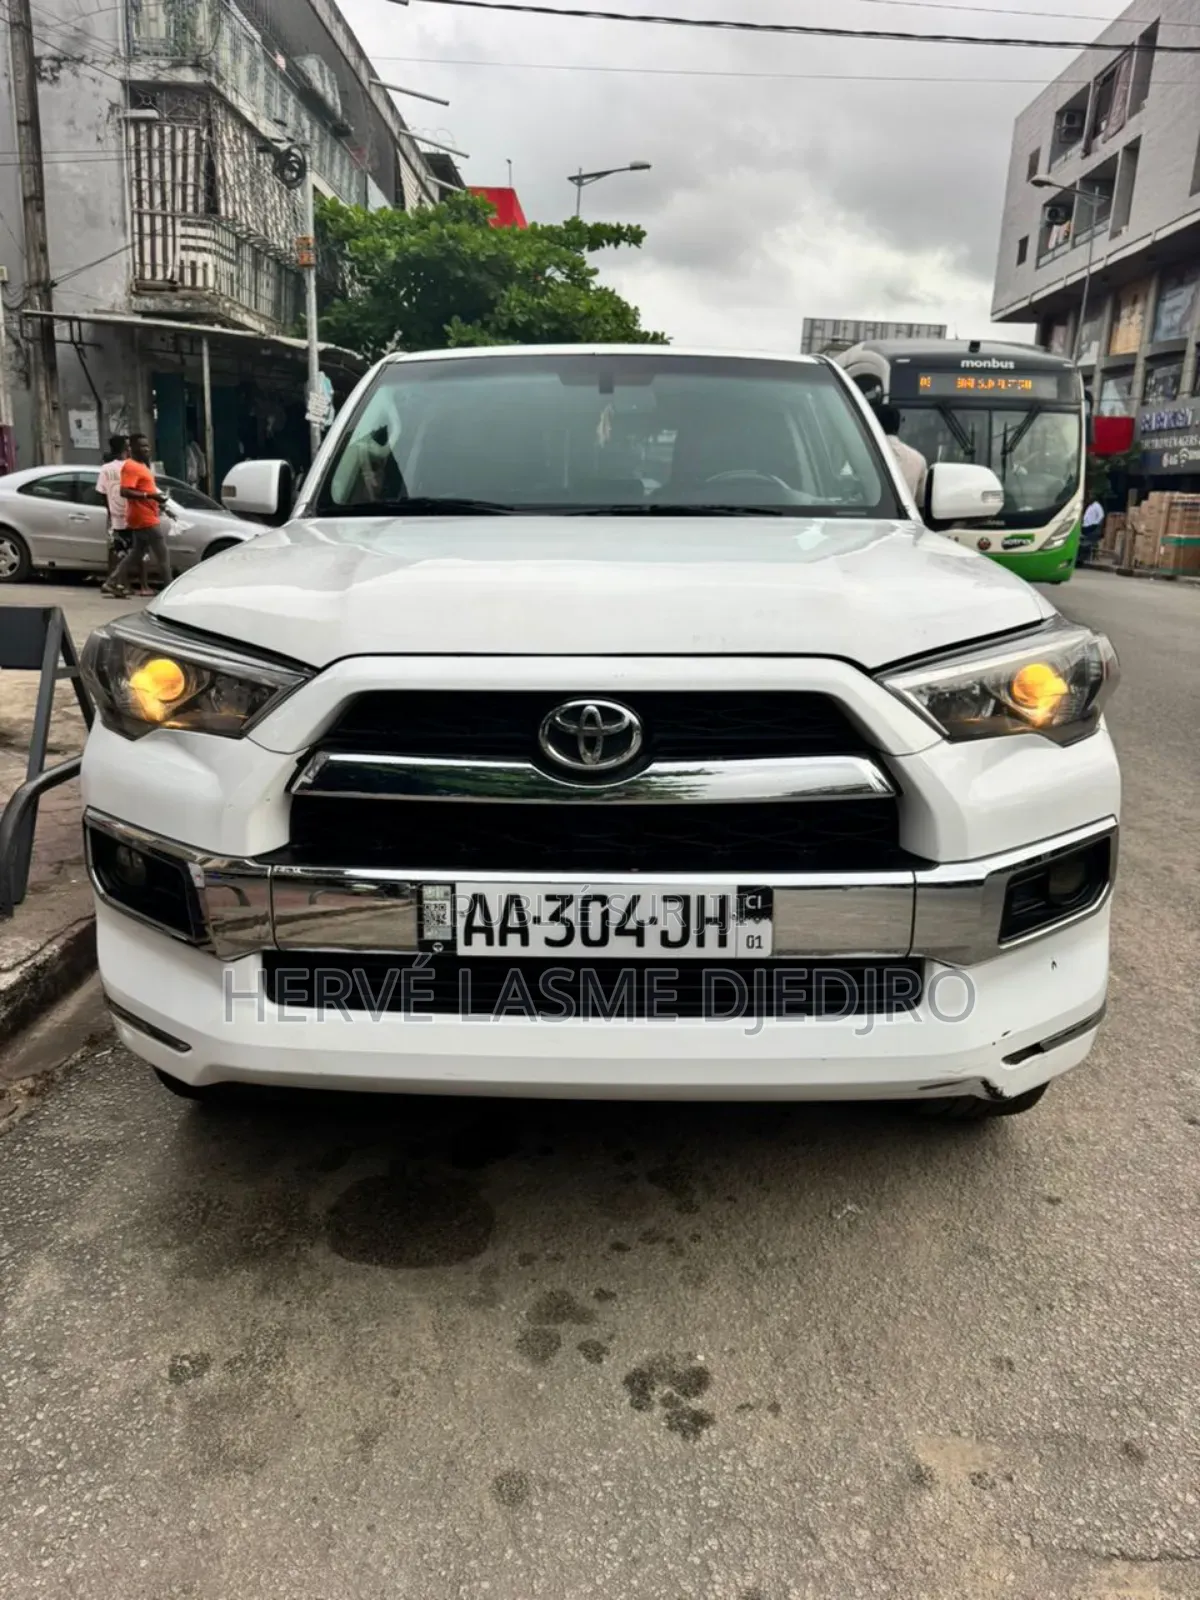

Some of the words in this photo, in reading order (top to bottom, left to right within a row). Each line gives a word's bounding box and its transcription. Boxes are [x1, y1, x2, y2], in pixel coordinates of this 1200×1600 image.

[960, 358, 1015, 370] monbus
[745, 895, 762, 909] CI
[745, 934, 764, 950] 01
